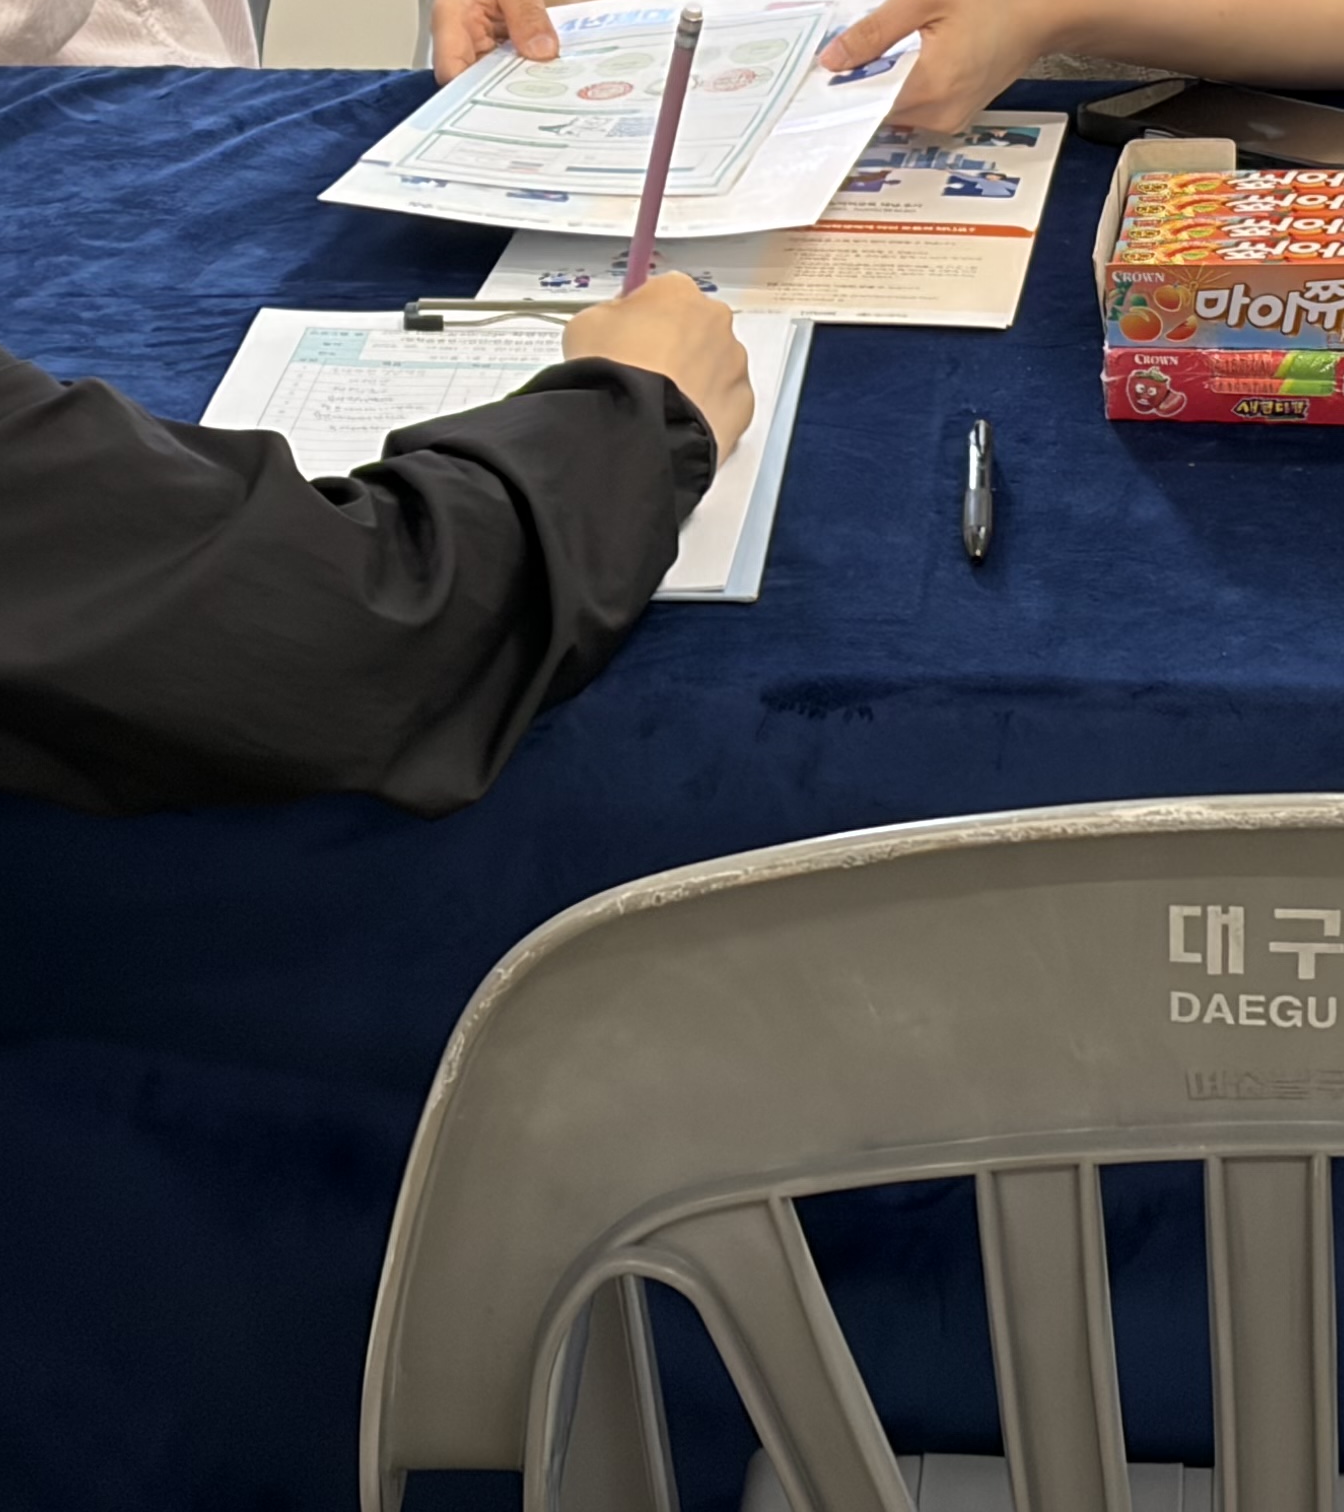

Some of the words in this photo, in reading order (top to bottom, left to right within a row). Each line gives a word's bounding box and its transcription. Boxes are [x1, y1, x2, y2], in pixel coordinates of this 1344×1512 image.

[1111, 270, 1166, 284] CROWN
[1134, 353, 1179, 366] CROWN
[1169, 990, 1338, 1029] DAEGU
